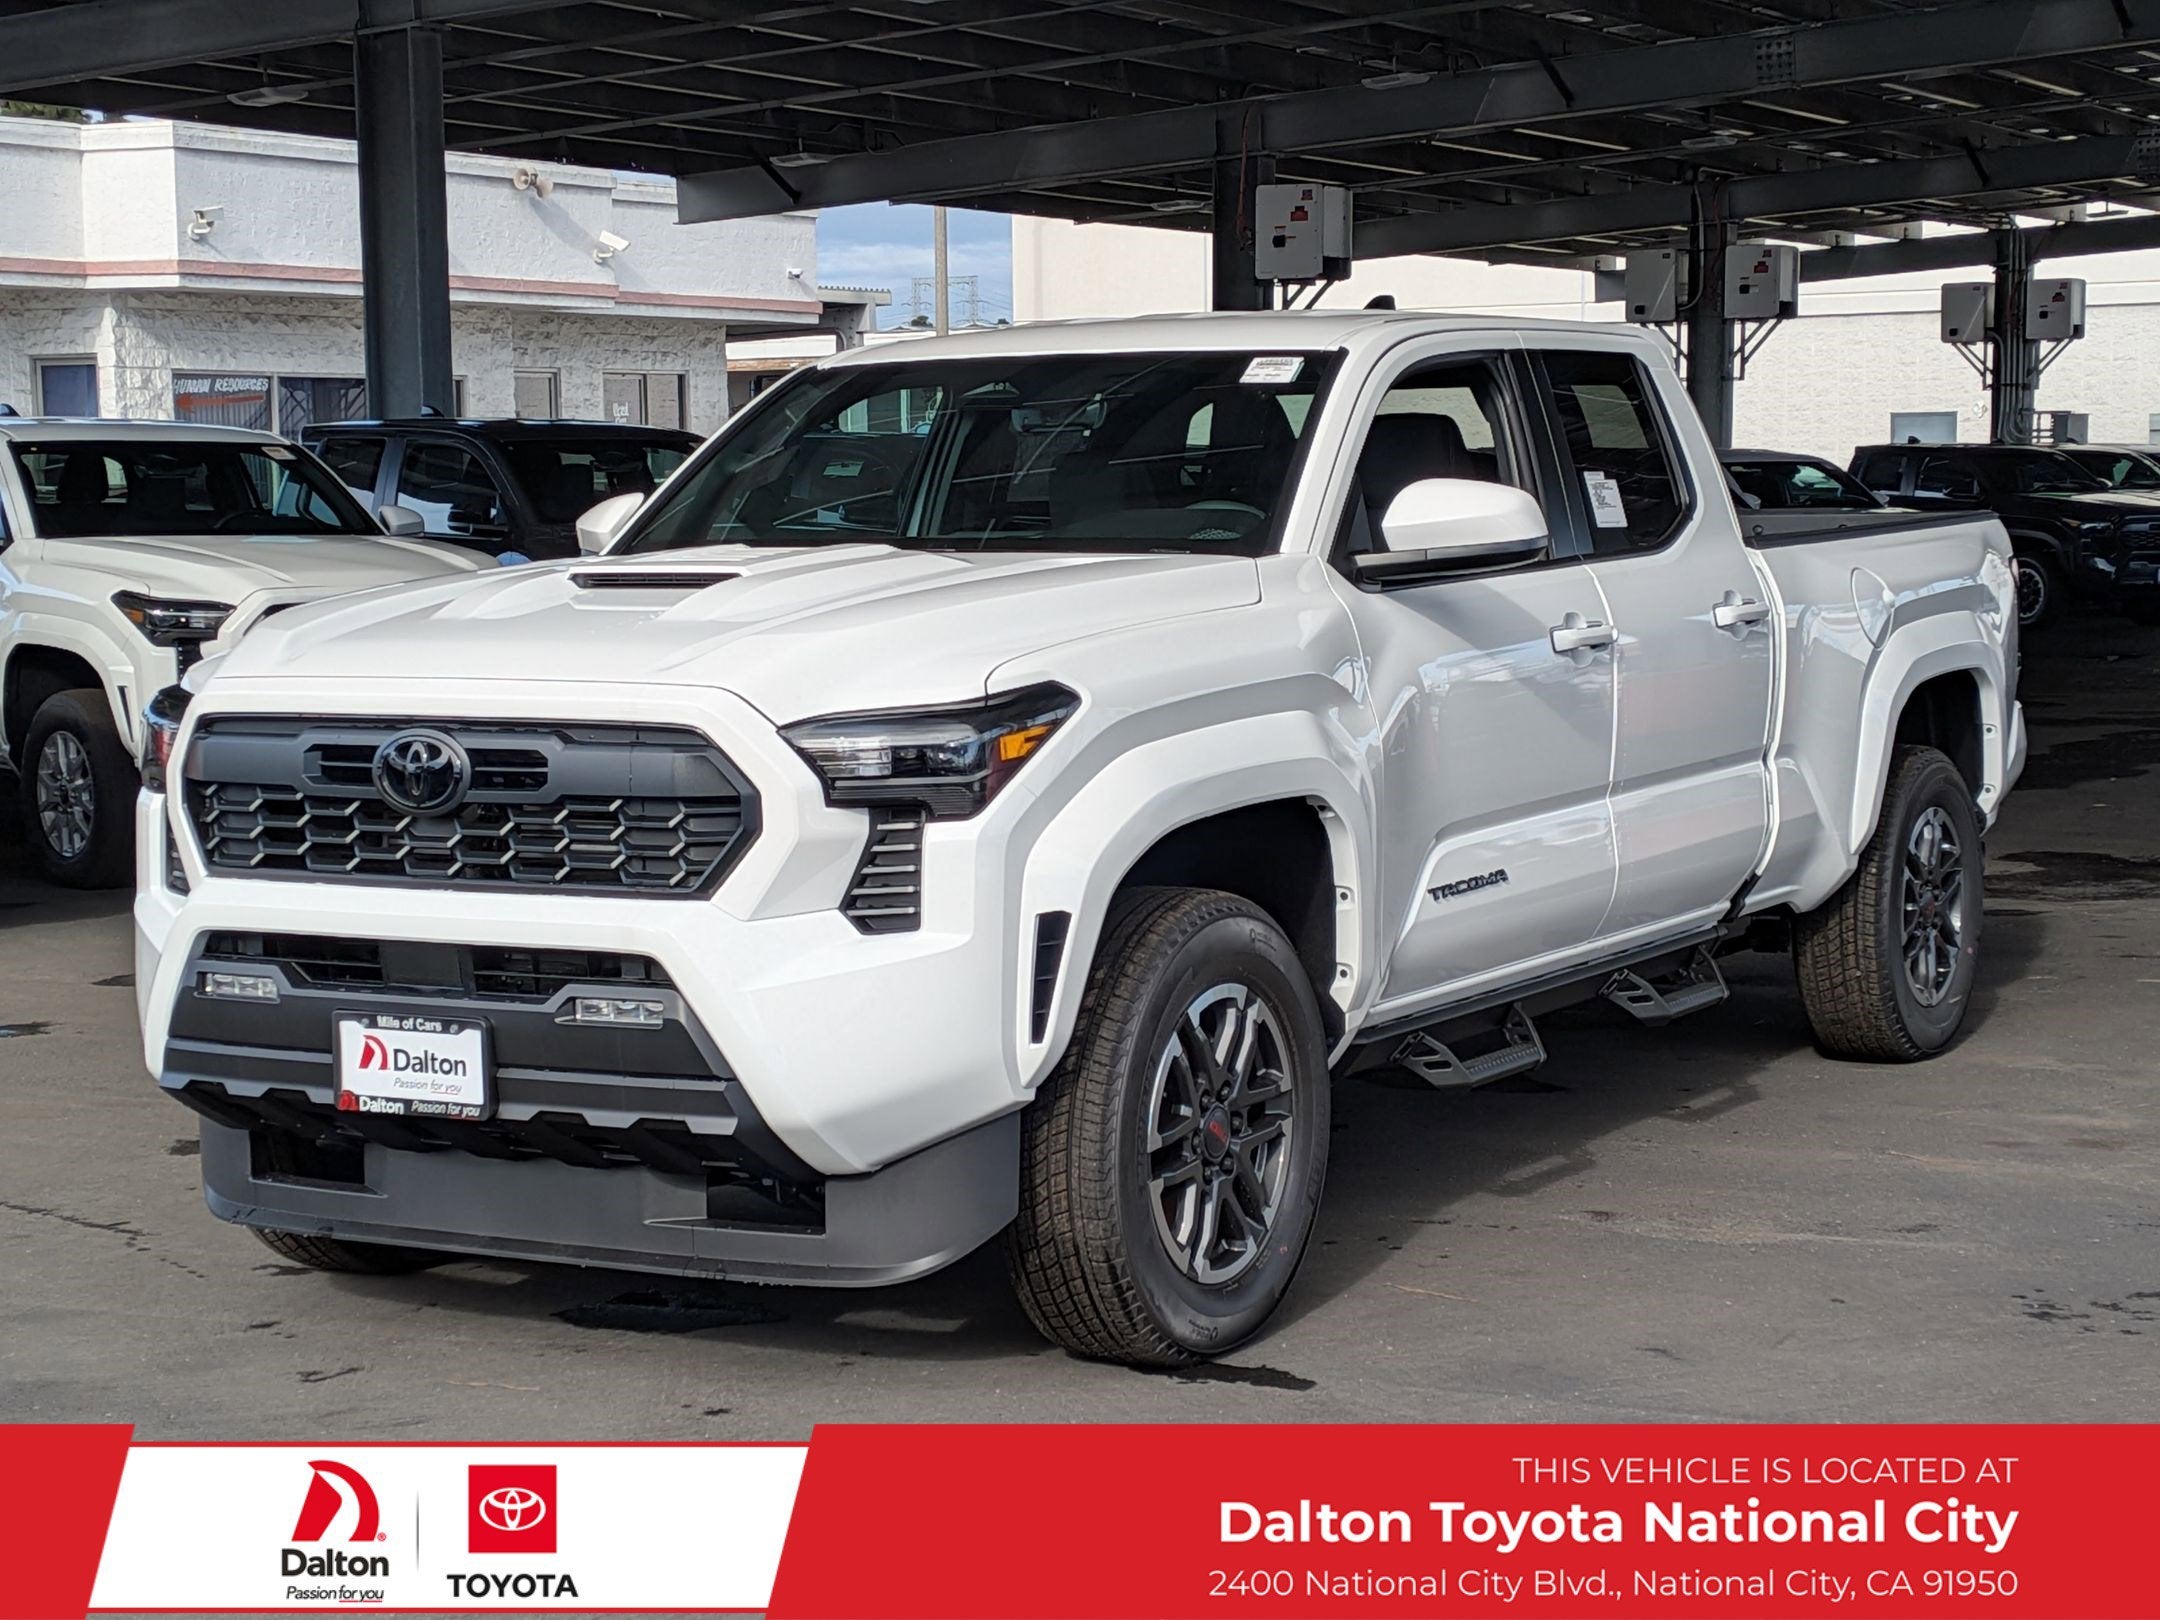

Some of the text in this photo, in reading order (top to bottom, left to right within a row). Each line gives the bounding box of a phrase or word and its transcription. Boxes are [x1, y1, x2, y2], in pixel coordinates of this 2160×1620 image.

[174, 377, 269, 394] HUMAN RESOURCES
[1427, 868, 1509, 902] TACOMA
[377, 1015, 442, 1031] Mile of Cars
[393, 1048, 467, 1077] Dalton
[393, 1077, 462, 1094] Passion for you
[359, 1096, 481, 1117] Dalton Passion for you
